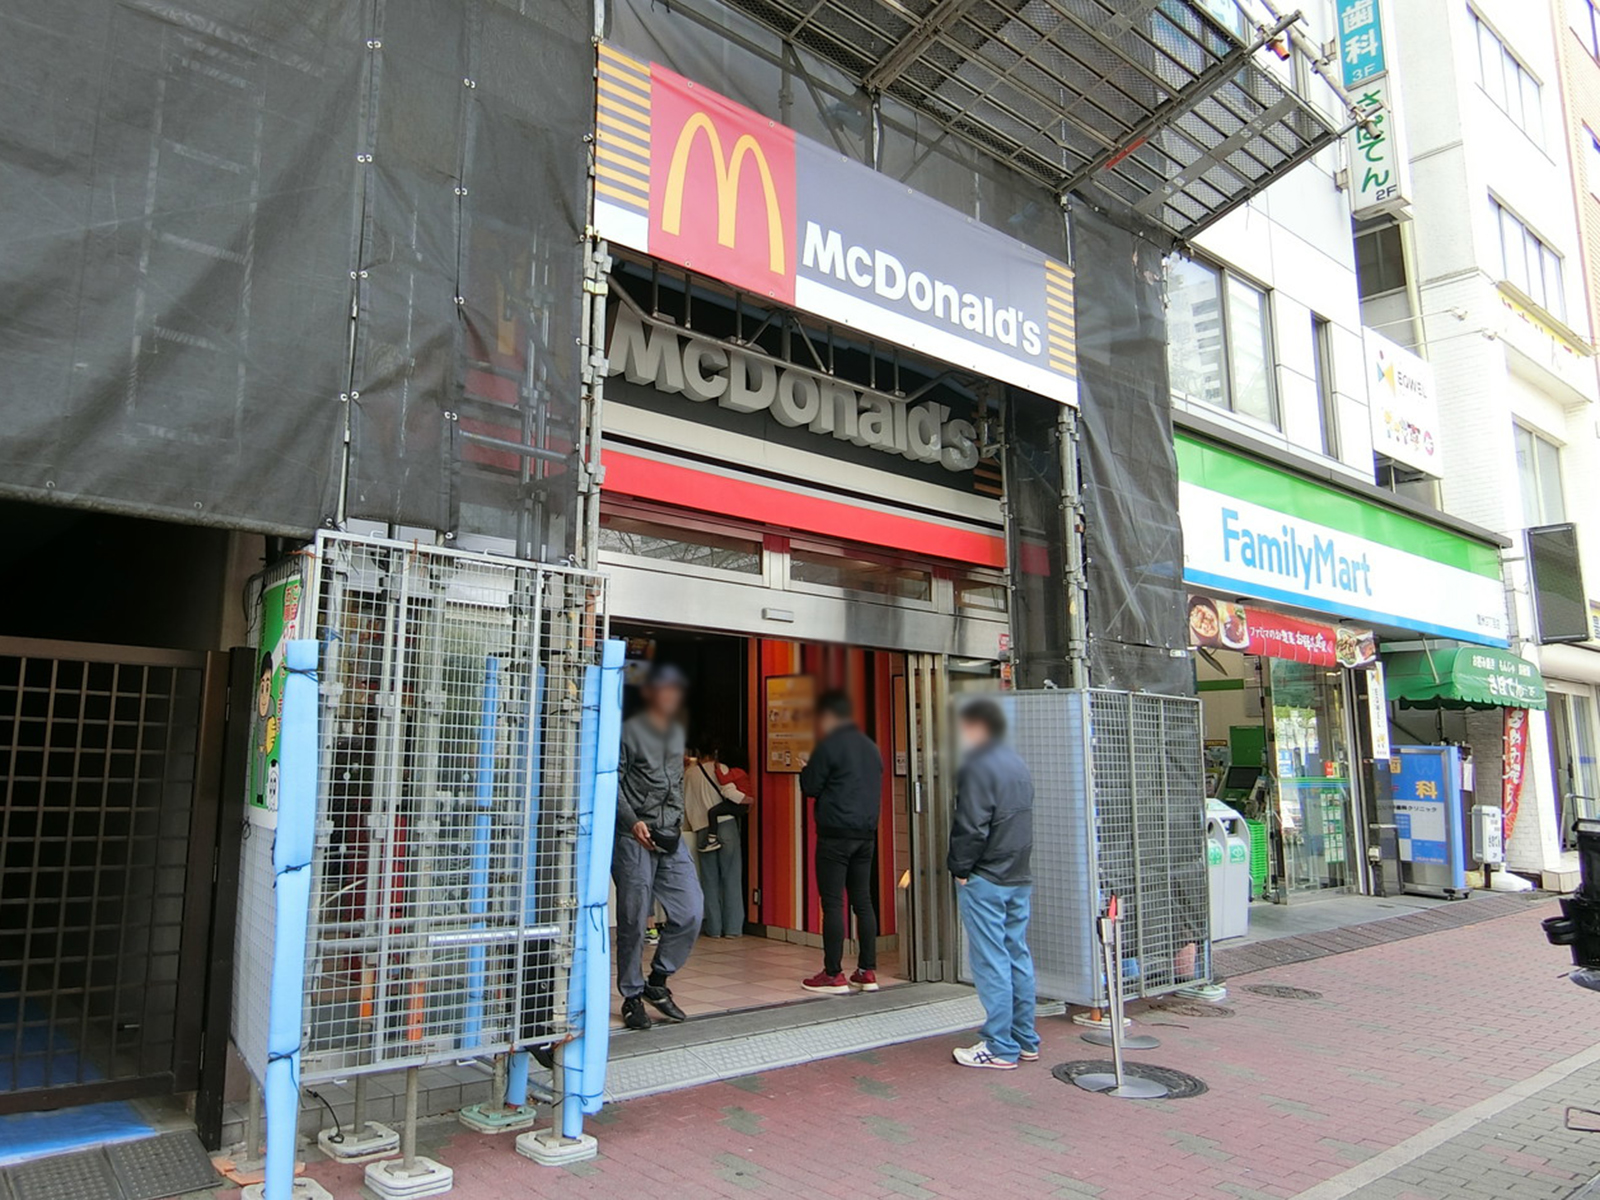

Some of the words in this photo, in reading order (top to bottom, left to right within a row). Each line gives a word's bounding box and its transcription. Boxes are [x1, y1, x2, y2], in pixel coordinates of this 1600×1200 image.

[1341, 0, 1378, 64] 歯科
[1352, 63, 1375, 81] 3F
[1376, 184, 1397, 201] 2F
[802, 220, 1042, 356] McDonald's
[607, 300, 980, 472] McDonald's
[1221, 506, 1373, 597] FamilyMart
